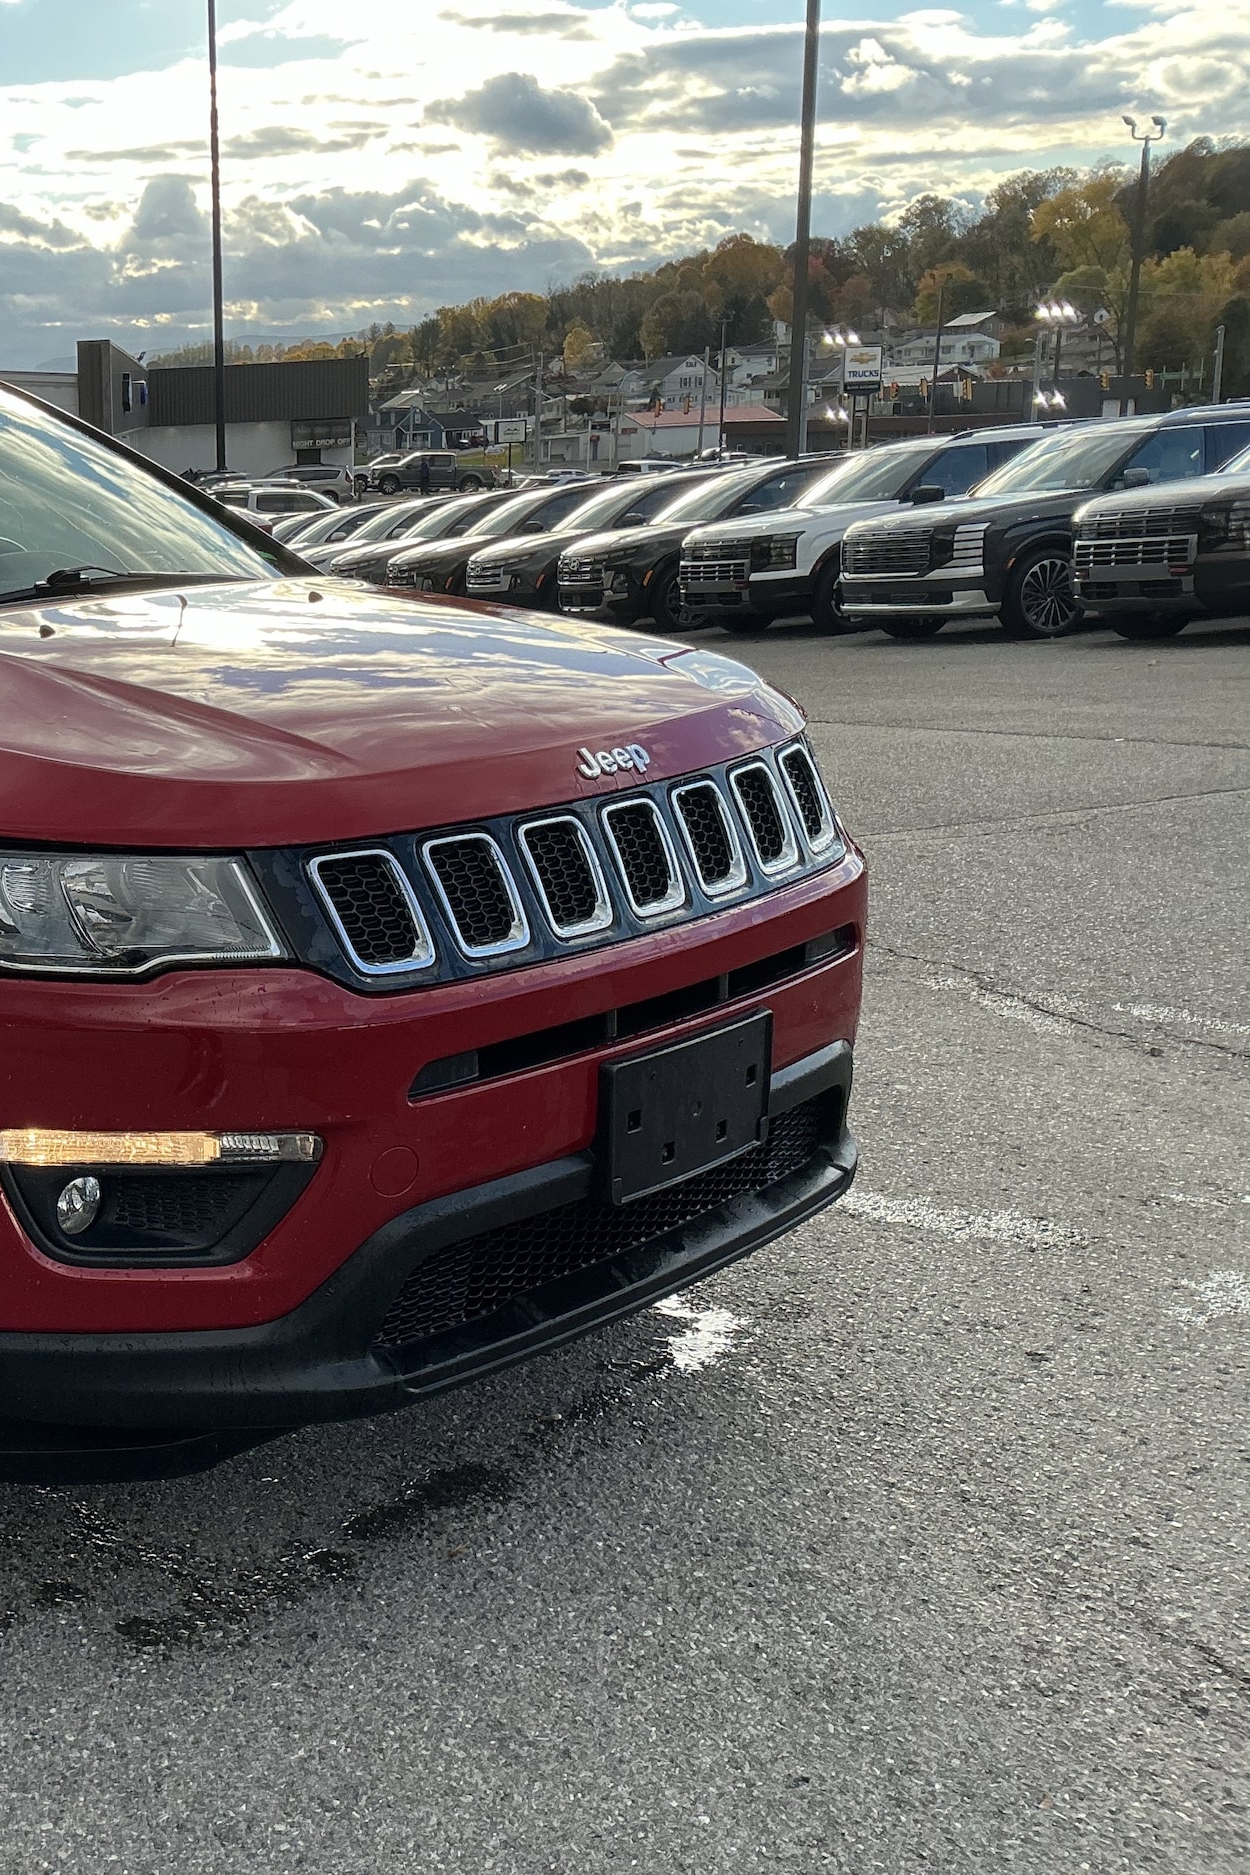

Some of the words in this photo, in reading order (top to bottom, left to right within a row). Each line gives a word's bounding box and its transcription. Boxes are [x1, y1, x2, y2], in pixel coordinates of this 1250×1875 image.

[848, 370, 879, 378] TRUCKS
[316, 439, 336, 447] DROP
[337, 438, 351, 446] OFF
[576, 744, 651, 779] Jeep
